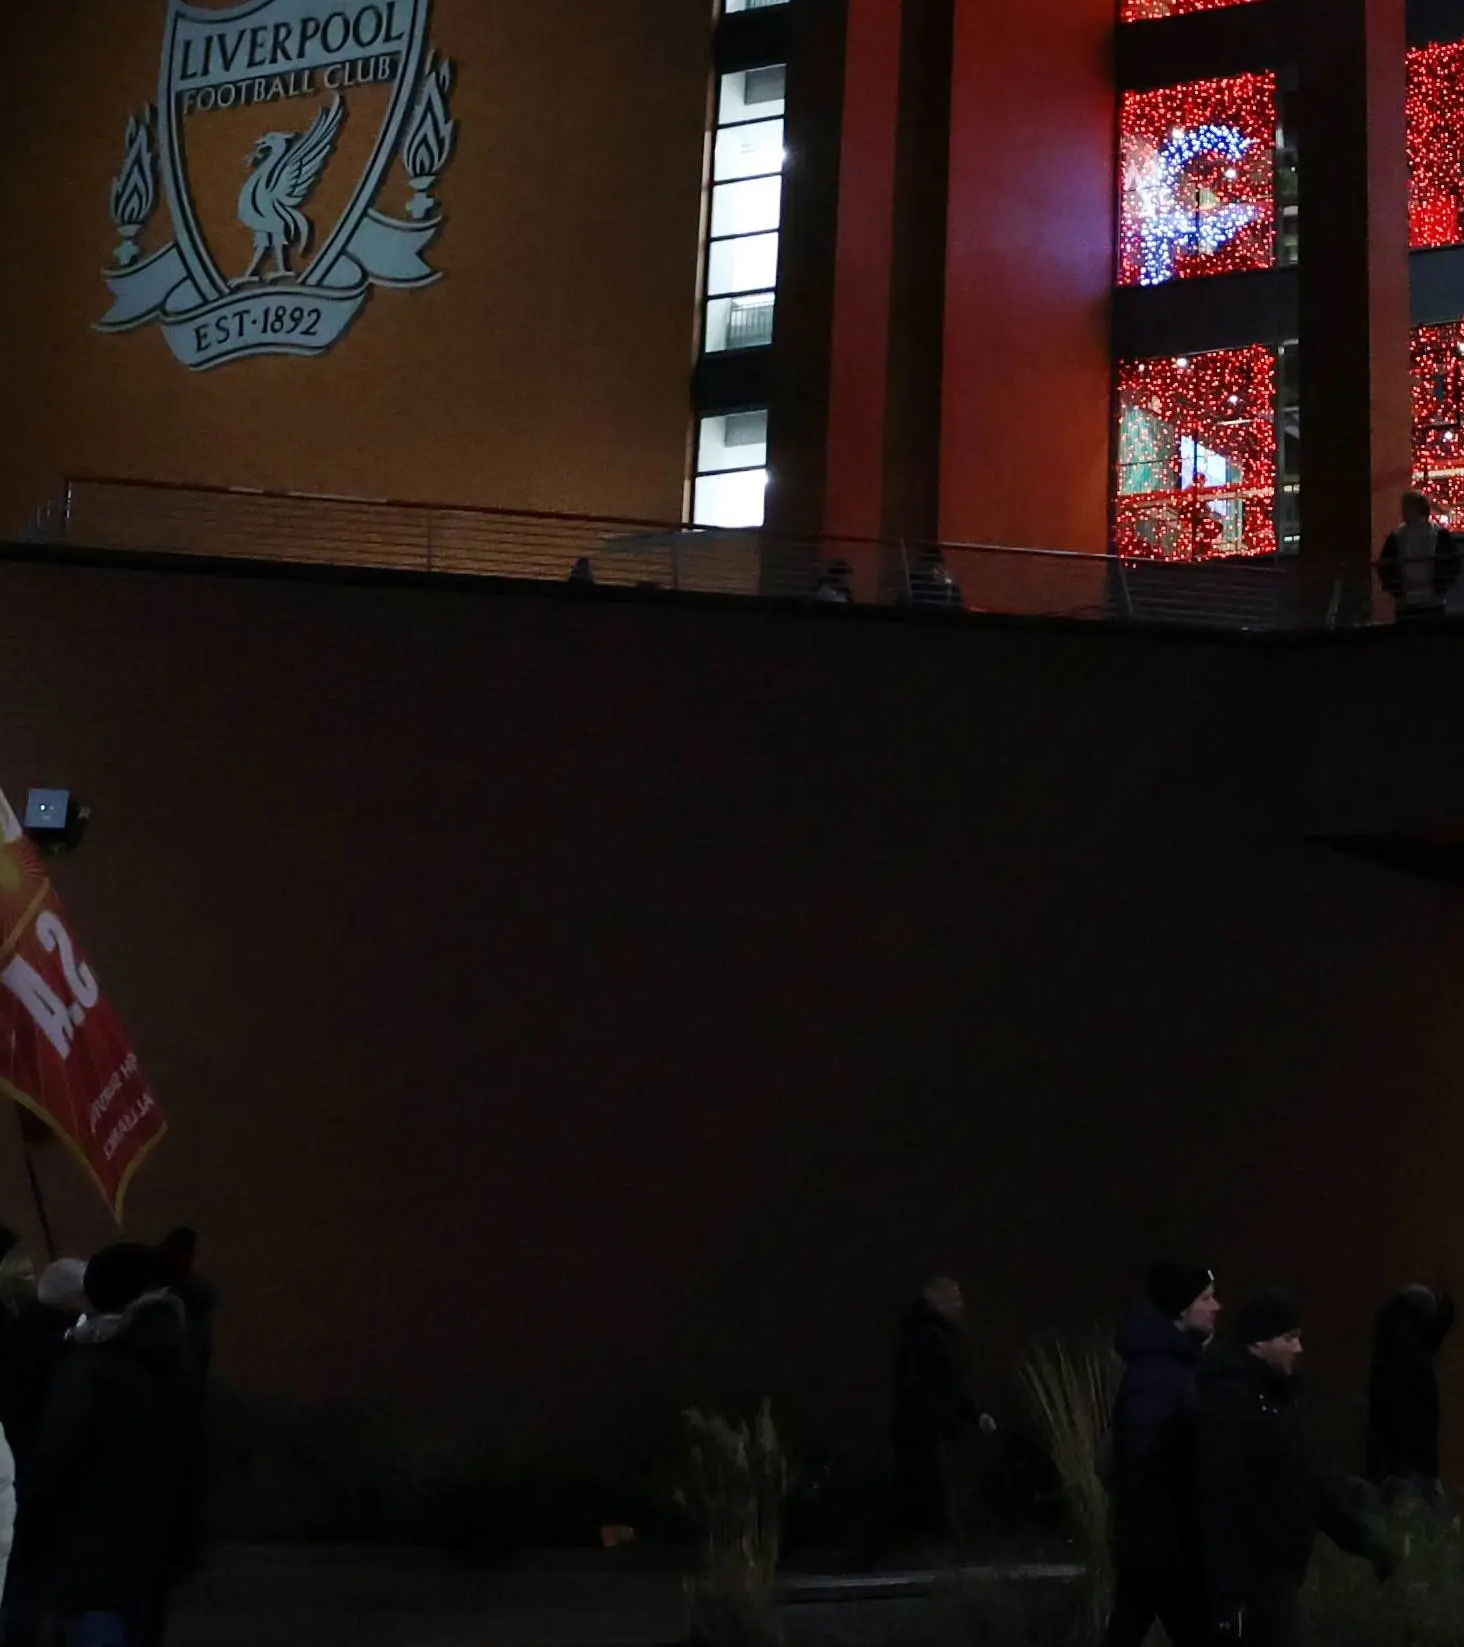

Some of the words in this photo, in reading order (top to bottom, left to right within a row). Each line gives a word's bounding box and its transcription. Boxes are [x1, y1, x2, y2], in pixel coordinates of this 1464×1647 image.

[179, 1, 404, 81] LIVERPOOL
[183, 69, 315, 115] FOOTBALL
[322, 55, 392, 91] CLUB
